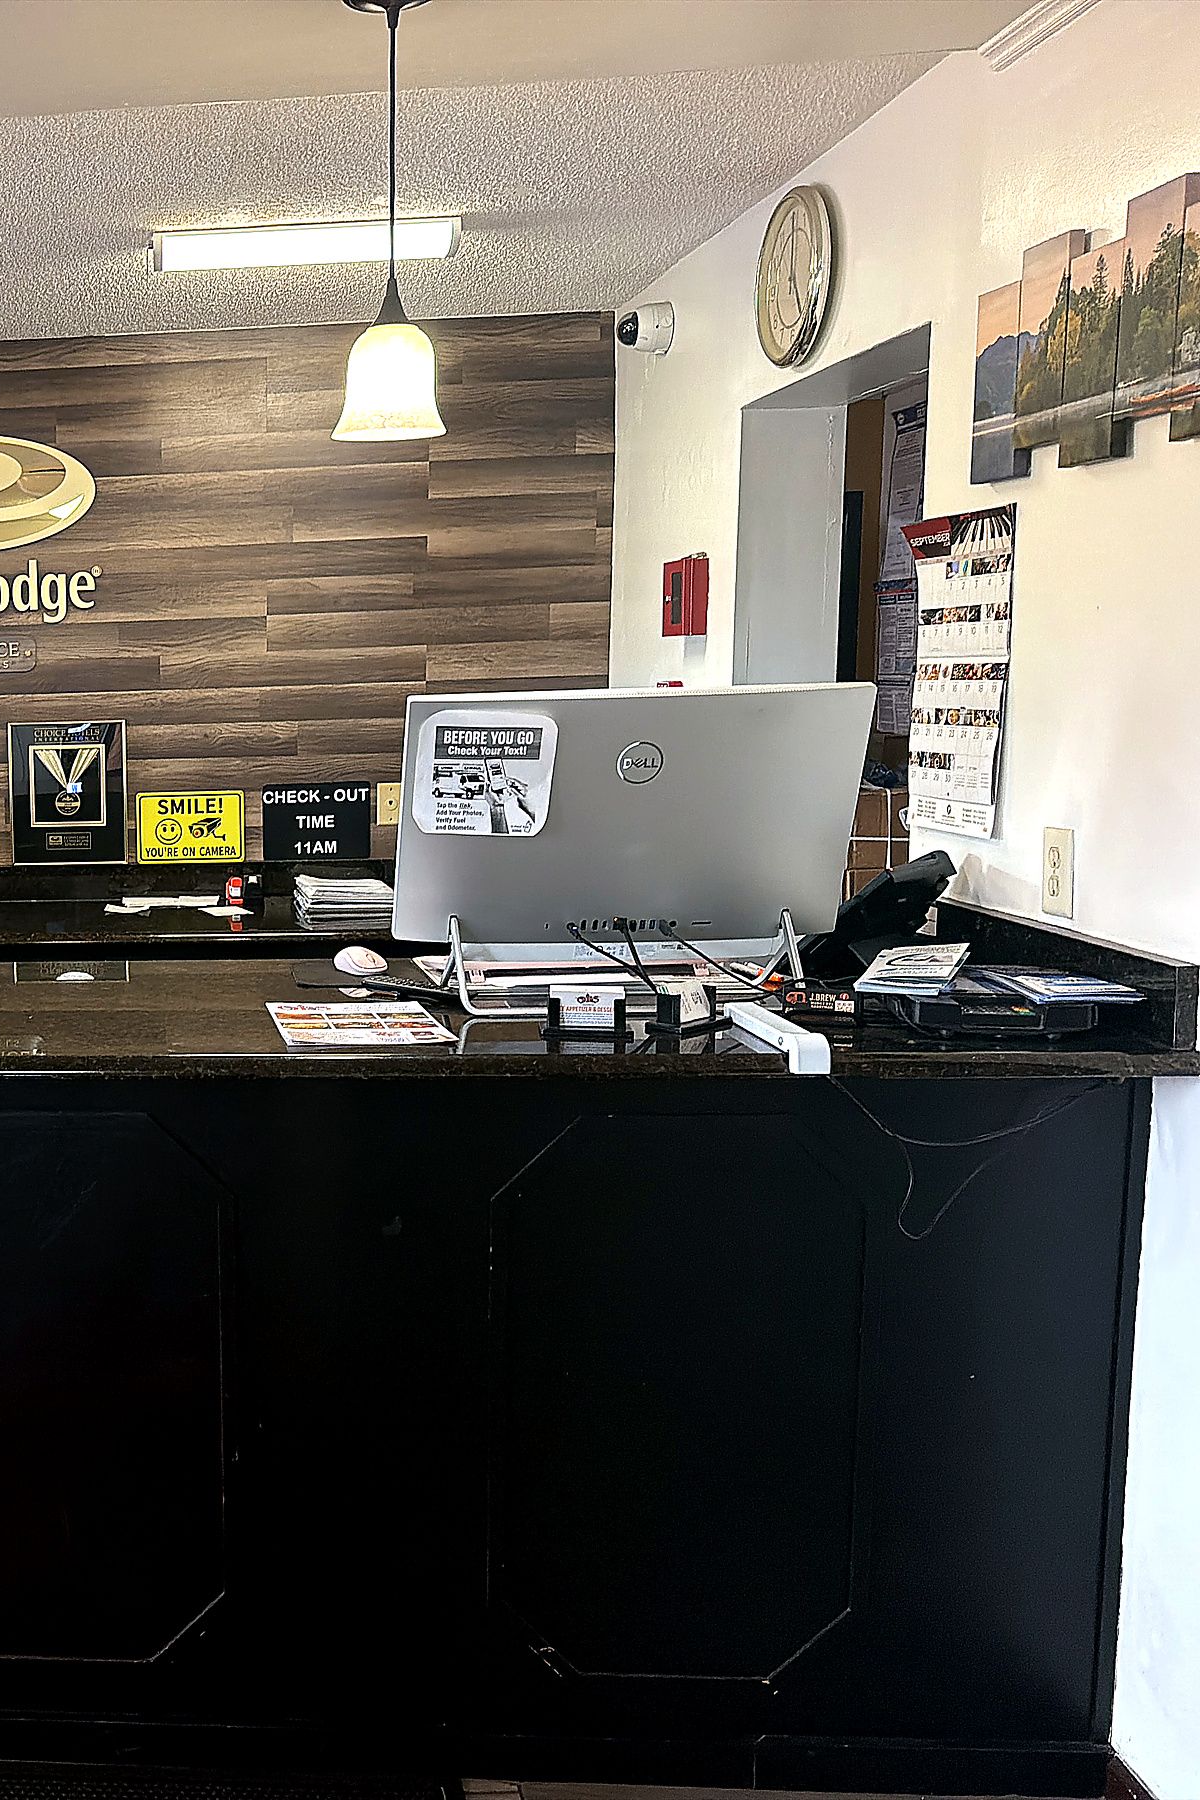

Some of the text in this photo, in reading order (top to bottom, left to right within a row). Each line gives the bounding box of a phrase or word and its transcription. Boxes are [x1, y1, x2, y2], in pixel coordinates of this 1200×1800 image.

[910, 532, 950, 547] SEPTEMBER
[34, 728, 65, 737] CHOICE
[444, 730, 534, 745] BEFORE YOU GO
[961, 729, 967, 738] 24
[973, 730, 980, 739] 25
[448, 745, 527, 756] Check Your Text!
[622, 758, 658, 770] DELL
[263, 790, 320, 804] CHECK
[333, 788, 369, 801] OUT
[157, 798, 223, 815] SMILE!
[296, 814, 335, 828] TIME
[145, 846, 236, 858] YOU'RE ON CAMERA
[294, 840, 337, 854] 11AM
[809, 993, 836, 1002] J.BREW
